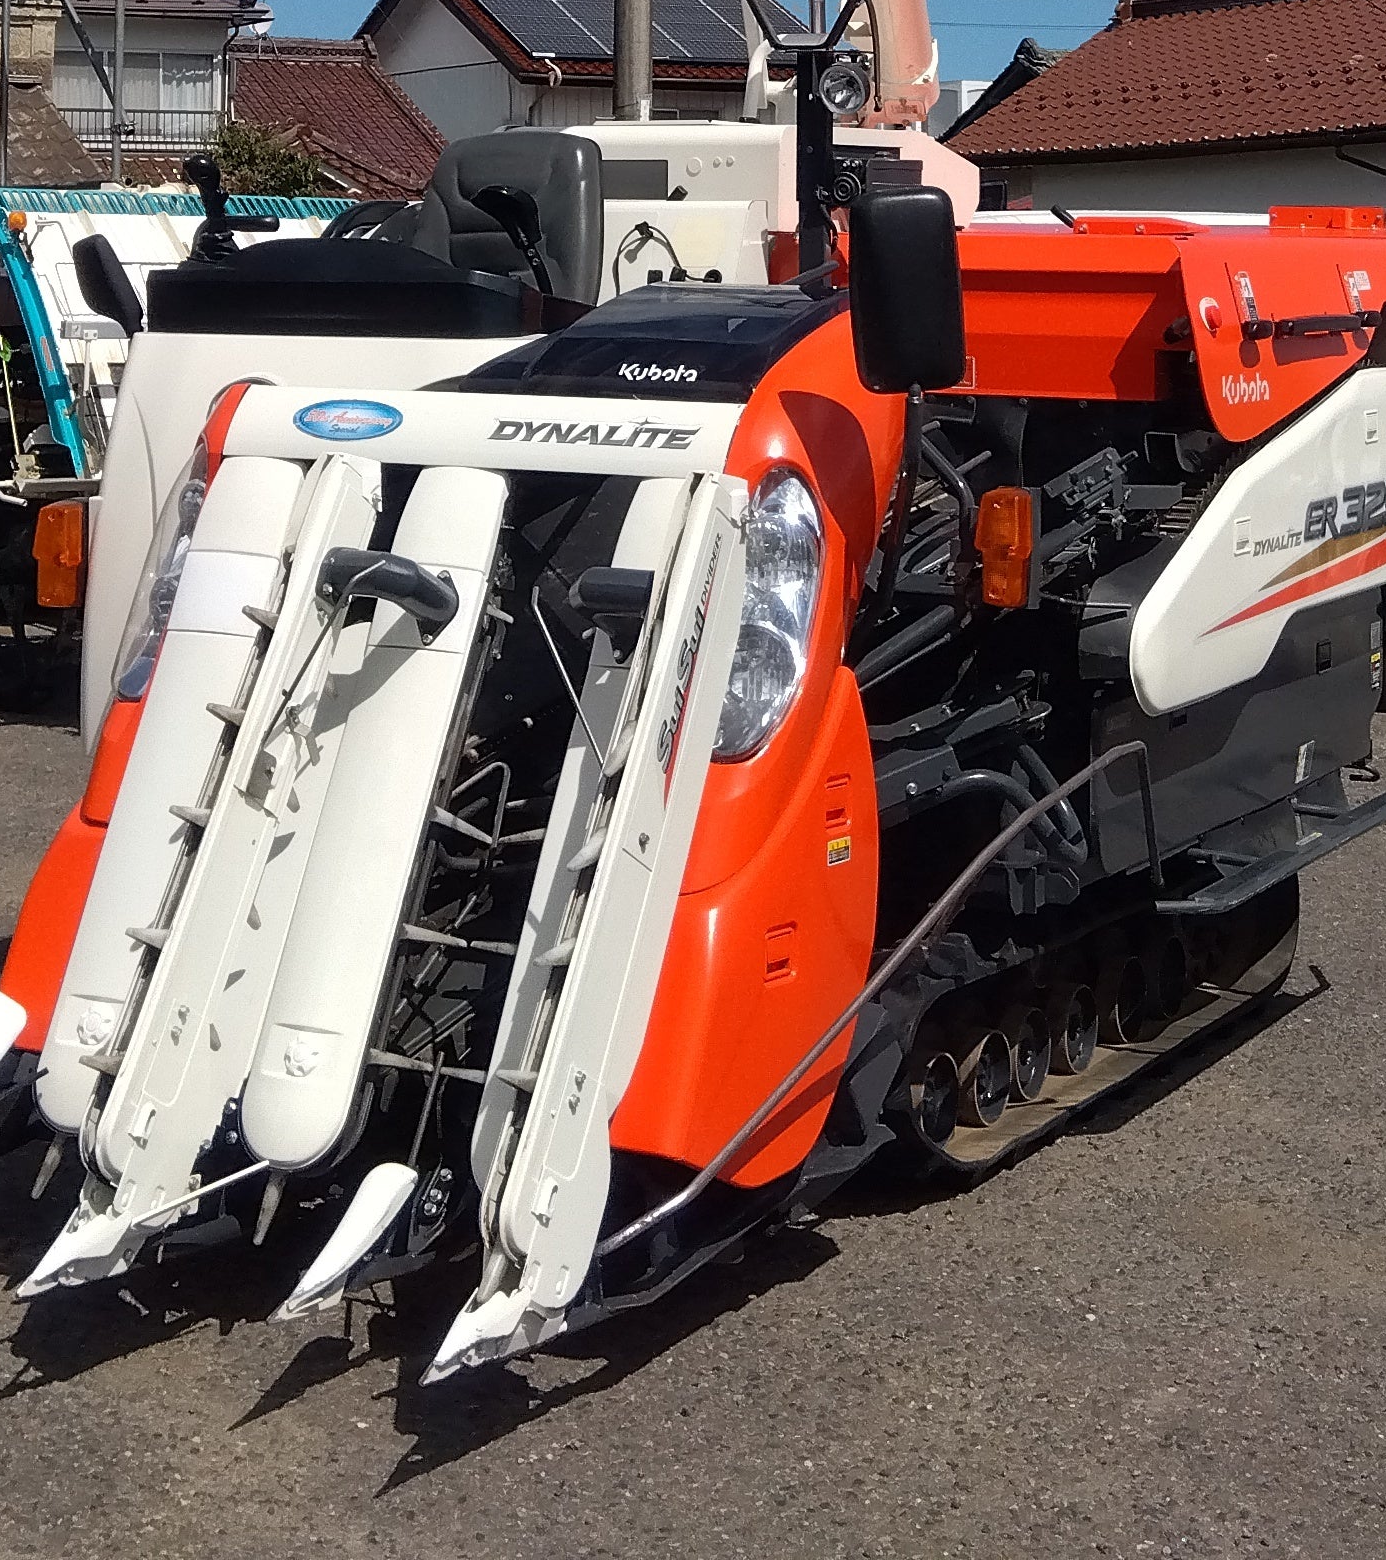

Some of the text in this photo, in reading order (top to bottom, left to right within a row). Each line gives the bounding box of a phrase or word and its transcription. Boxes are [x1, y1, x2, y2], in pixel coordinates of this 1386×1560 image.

[618, 363, 699, 382] Kubota
[1222, 372, 1270, 405] Kubota
[487, 417, 702, 450] DYNALITE
[1253, 530, 1303, 557] DYNALITE
[700, 533, 723, 605] DIVIDER
